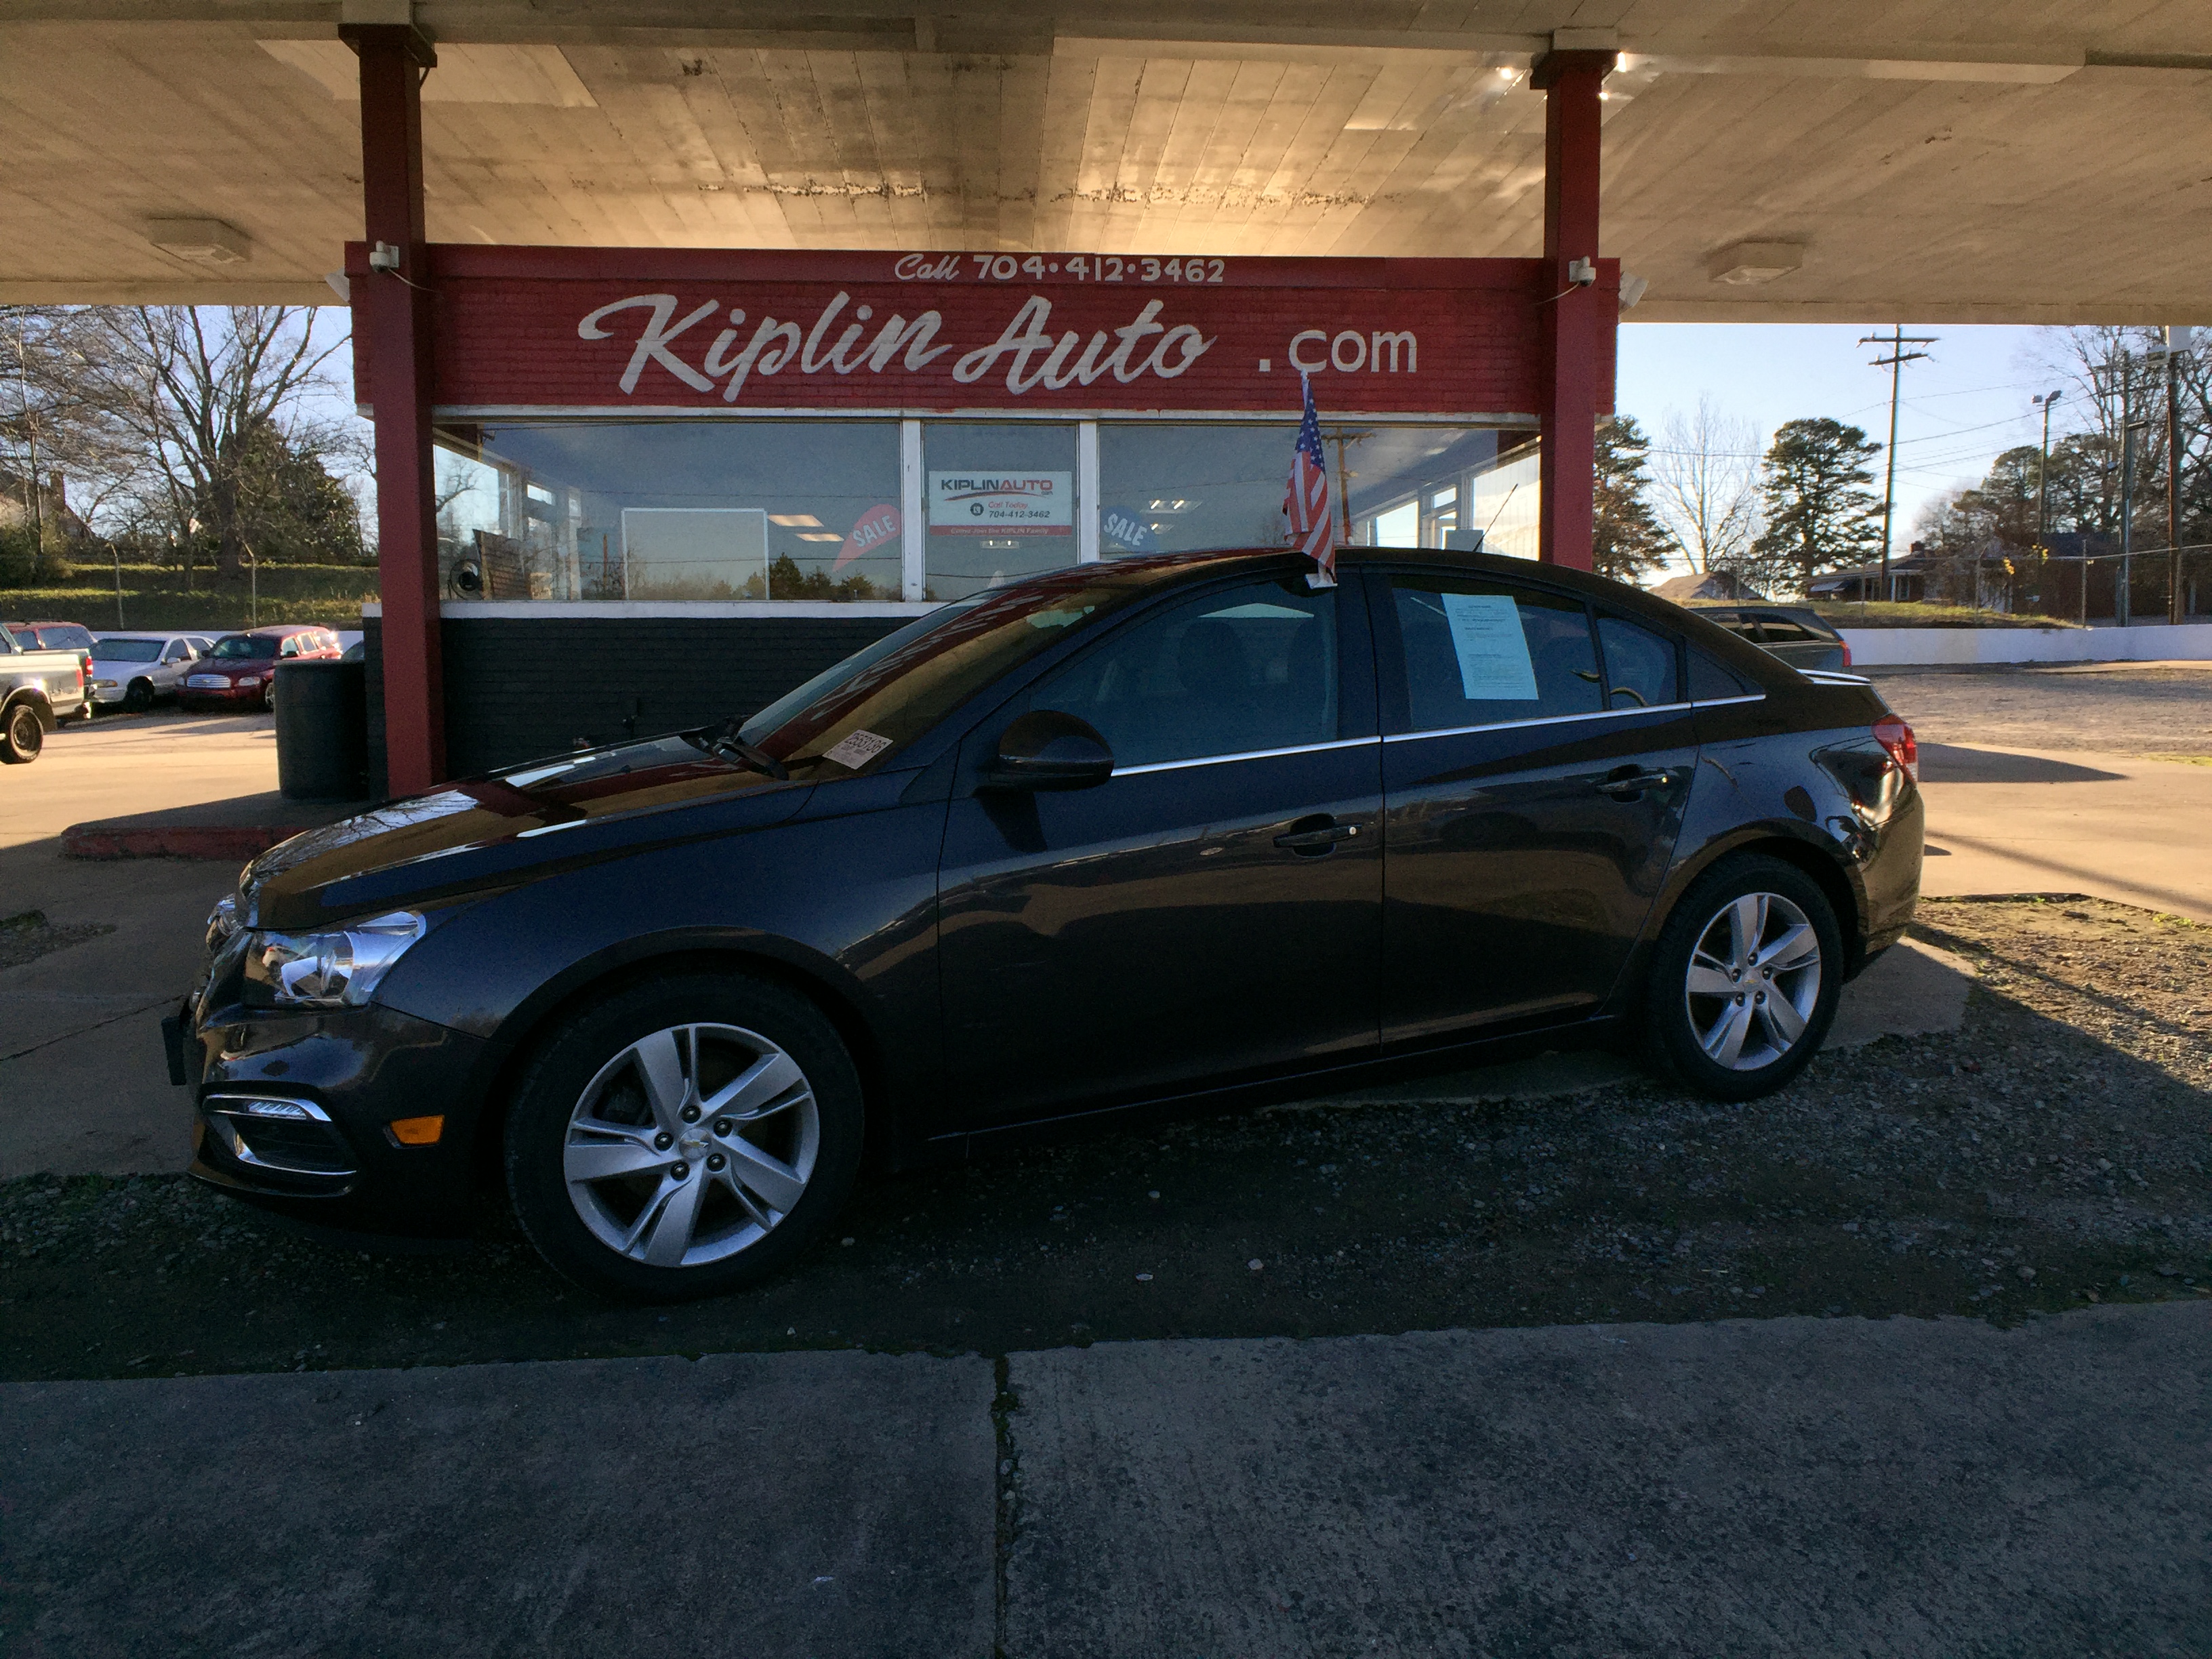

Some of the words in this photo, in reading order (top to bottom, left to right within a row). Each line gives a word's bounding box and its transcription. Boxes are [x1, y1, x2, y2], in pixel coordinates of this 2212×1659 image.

[895, 253, 960, 281] Call
[578, 291, 953, 403] Kiplin
[952, 295, 1217, 394] Auto
[1259, 330, 1417, 373] .com
[941, 479, 1053, 491] KIPLINAUTO
[989, 510, 1050, 518] 704-412-3462
[1005, 501, 1028, 510] Today
[853, 515, 897, 547] SALE
[1103, 513, 1147, 546] SALE
